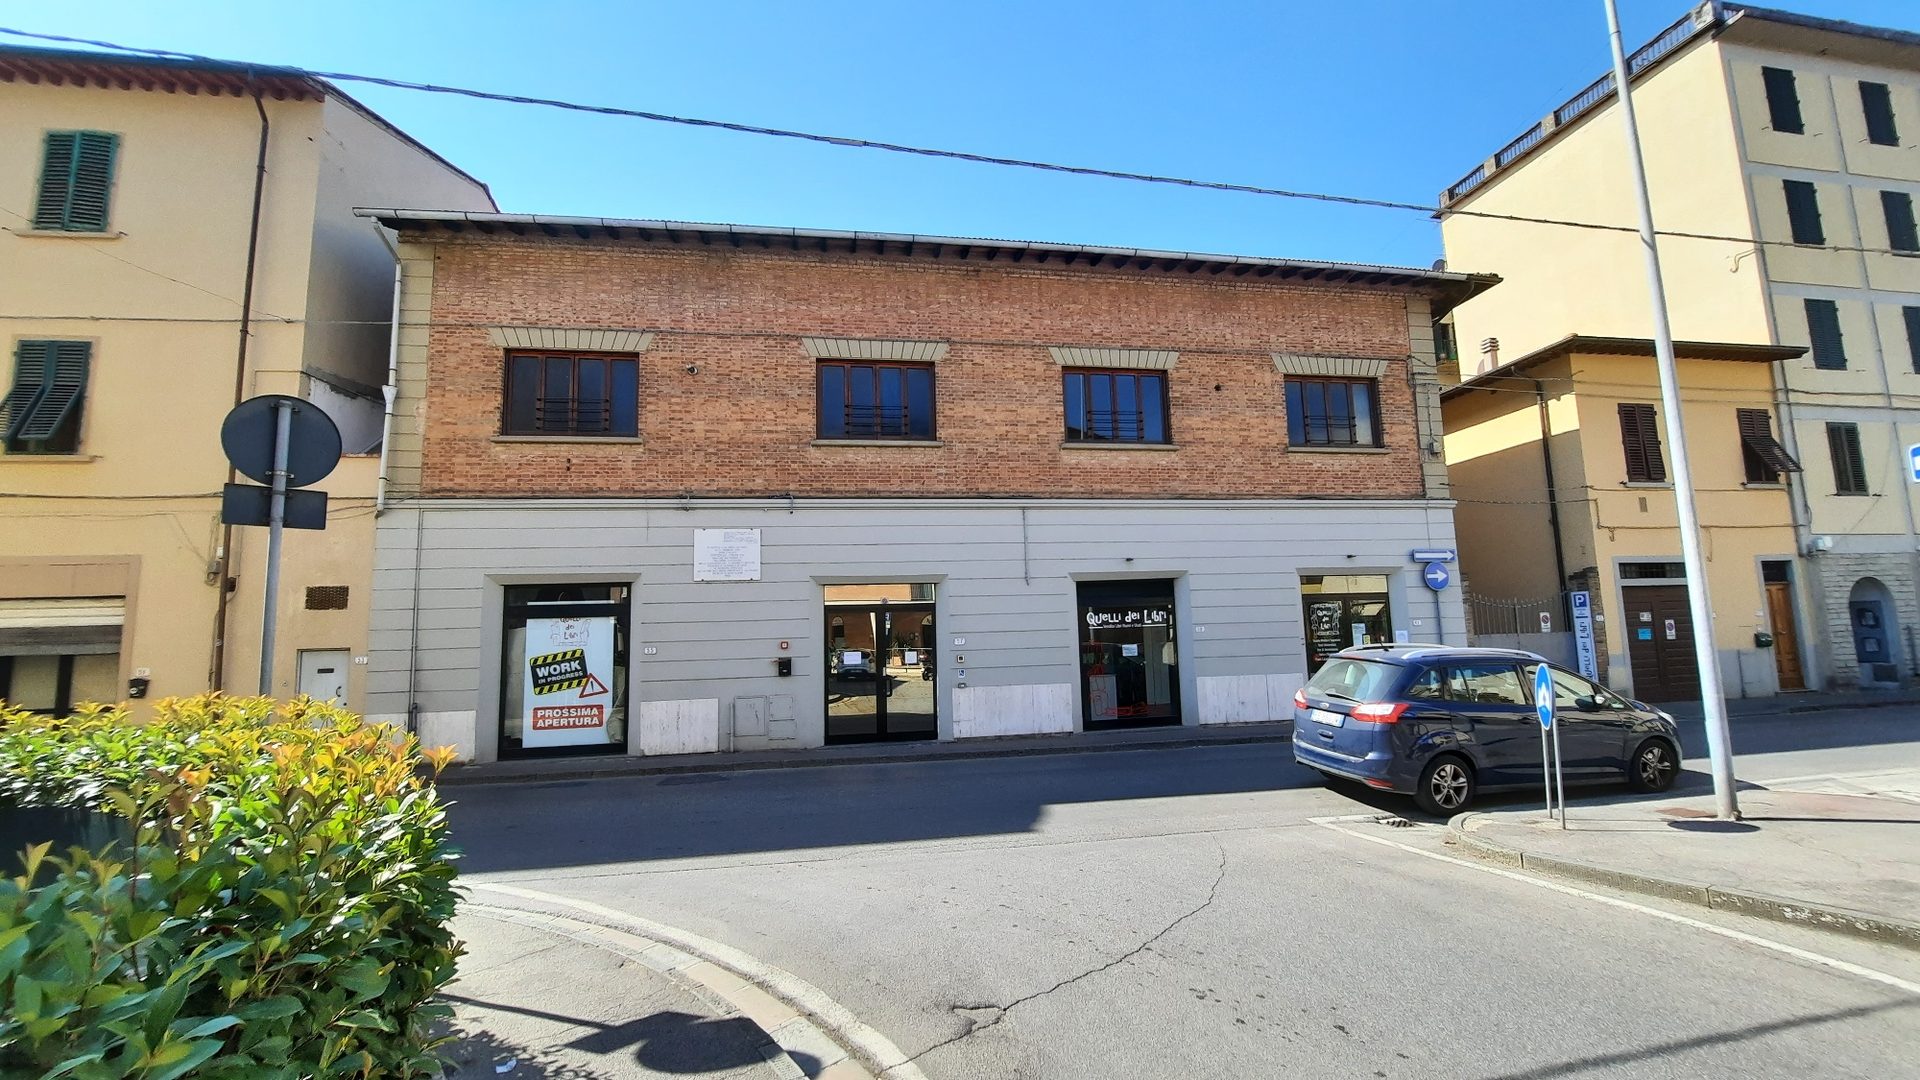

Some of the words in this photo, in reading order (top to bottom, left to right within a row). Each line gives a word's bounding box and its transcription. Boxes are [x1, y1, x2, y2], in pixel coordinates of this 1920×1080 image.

[1125, 611, 1140, 622] dei
[1143, 609, 1167, 624] Libri
[536, 660, 581, 678] WORK
[547, 671, 584, 682] PROGRESS
[537, 707, 599, 718] PROSSIMA
[536, 717, 600, 728] APERTURA
